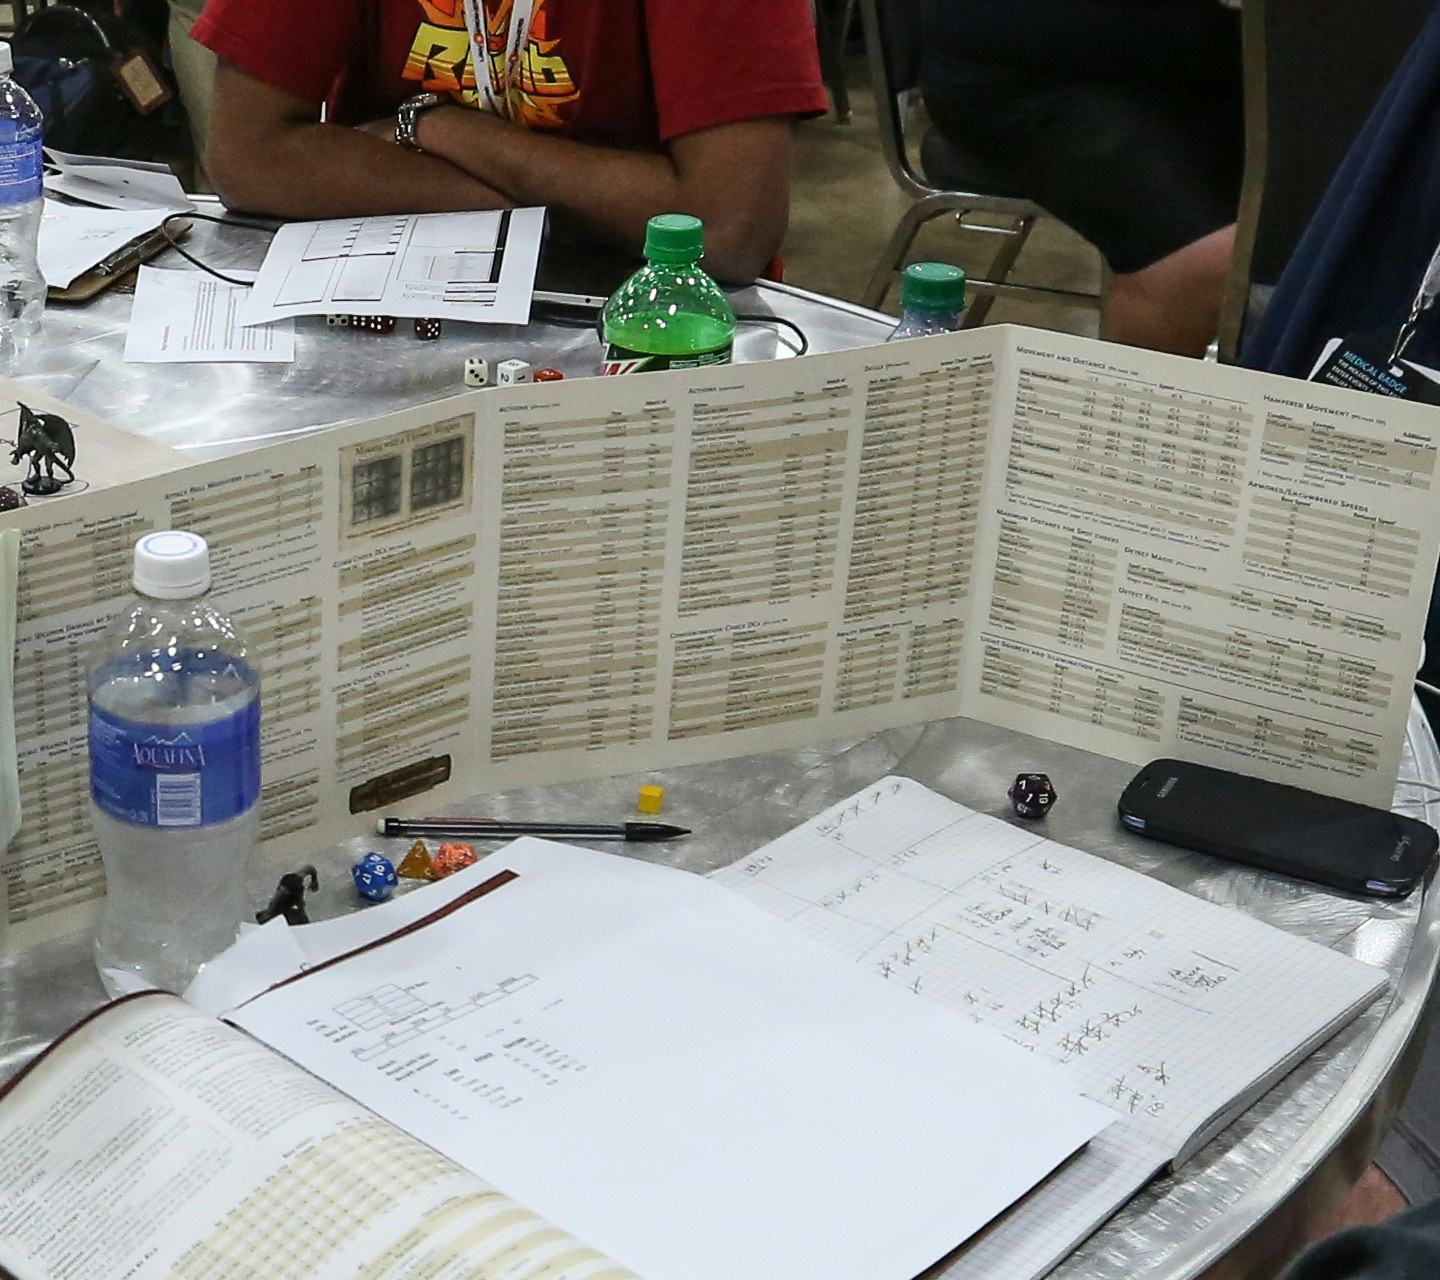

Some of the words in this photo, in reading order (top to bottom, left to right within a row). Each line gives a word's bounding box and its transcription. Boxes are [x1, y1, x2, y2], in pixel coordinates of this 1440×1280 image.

[1016, 346, 1054, 360] MOVEMENT
[1056, 355, 1072, 364] AND
[1073, 356, 1107, 370] DISTANCE
[1343, 351, 1378, 377] MEDICAL
[1378, 372, 1407, 394] BADGE
[1263, 394, 1304, 409] HAMPERED
[1306, 403, 1350, 417] MOVEMENT
[1340, 500, 1369, 513] SPEEDS
[1118, 586, 1143, 599] DETECT
[1144, 593, 1160, 604] EVIL
[132, 742, 206, 767] AQUAFINA
